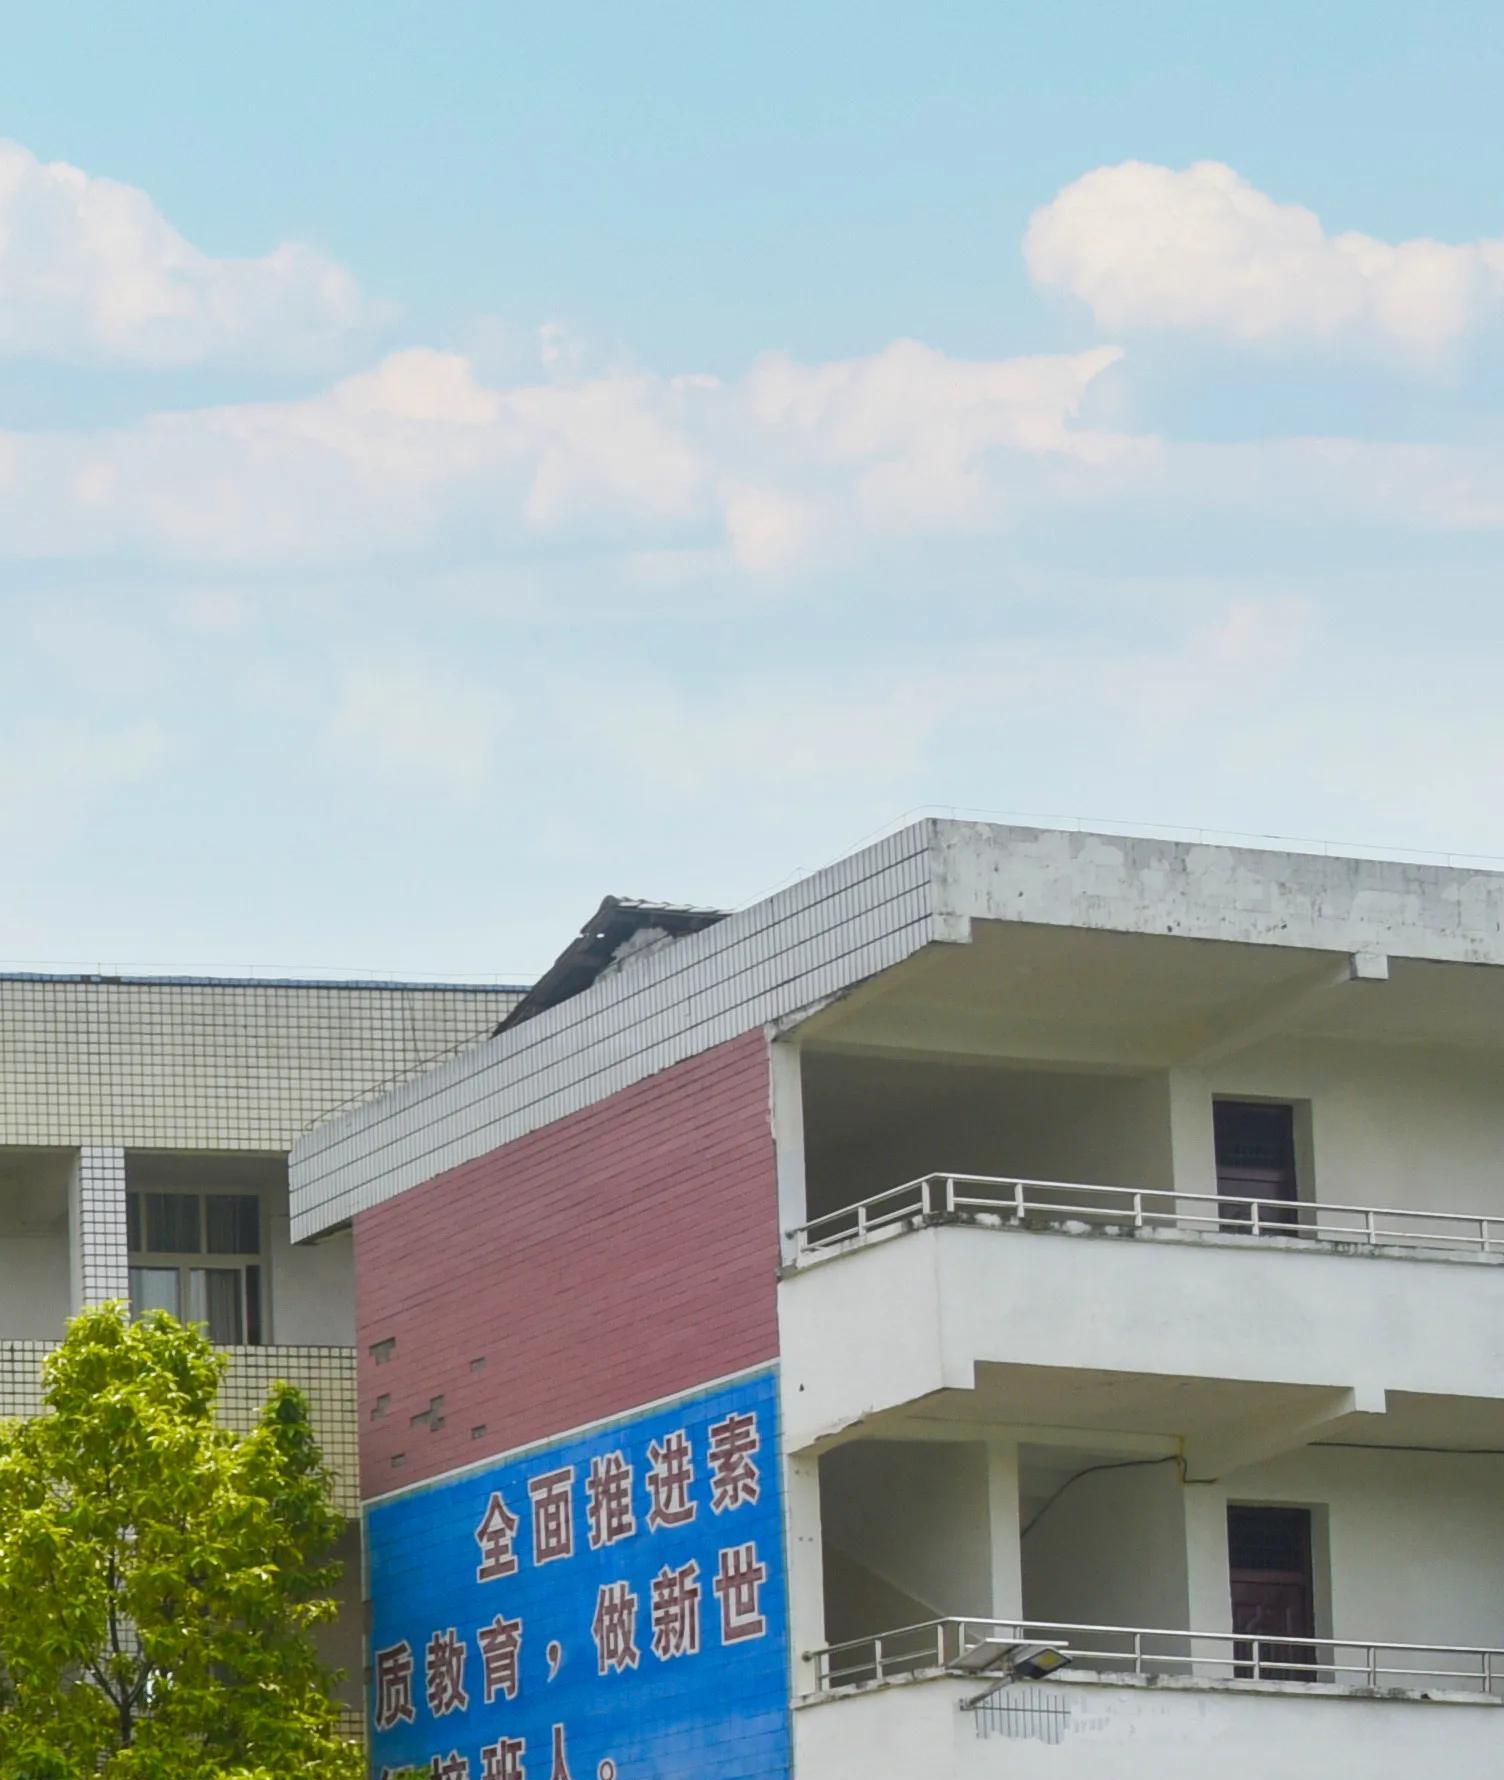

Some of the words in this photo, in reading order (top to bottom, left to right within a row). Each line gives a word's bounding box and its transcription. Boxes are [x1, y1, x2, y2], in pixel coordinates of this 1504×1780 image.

[474, 1411, 759, 1583] 全面推进素
[374, 1540, 768, 1732] 质教育，做新世
